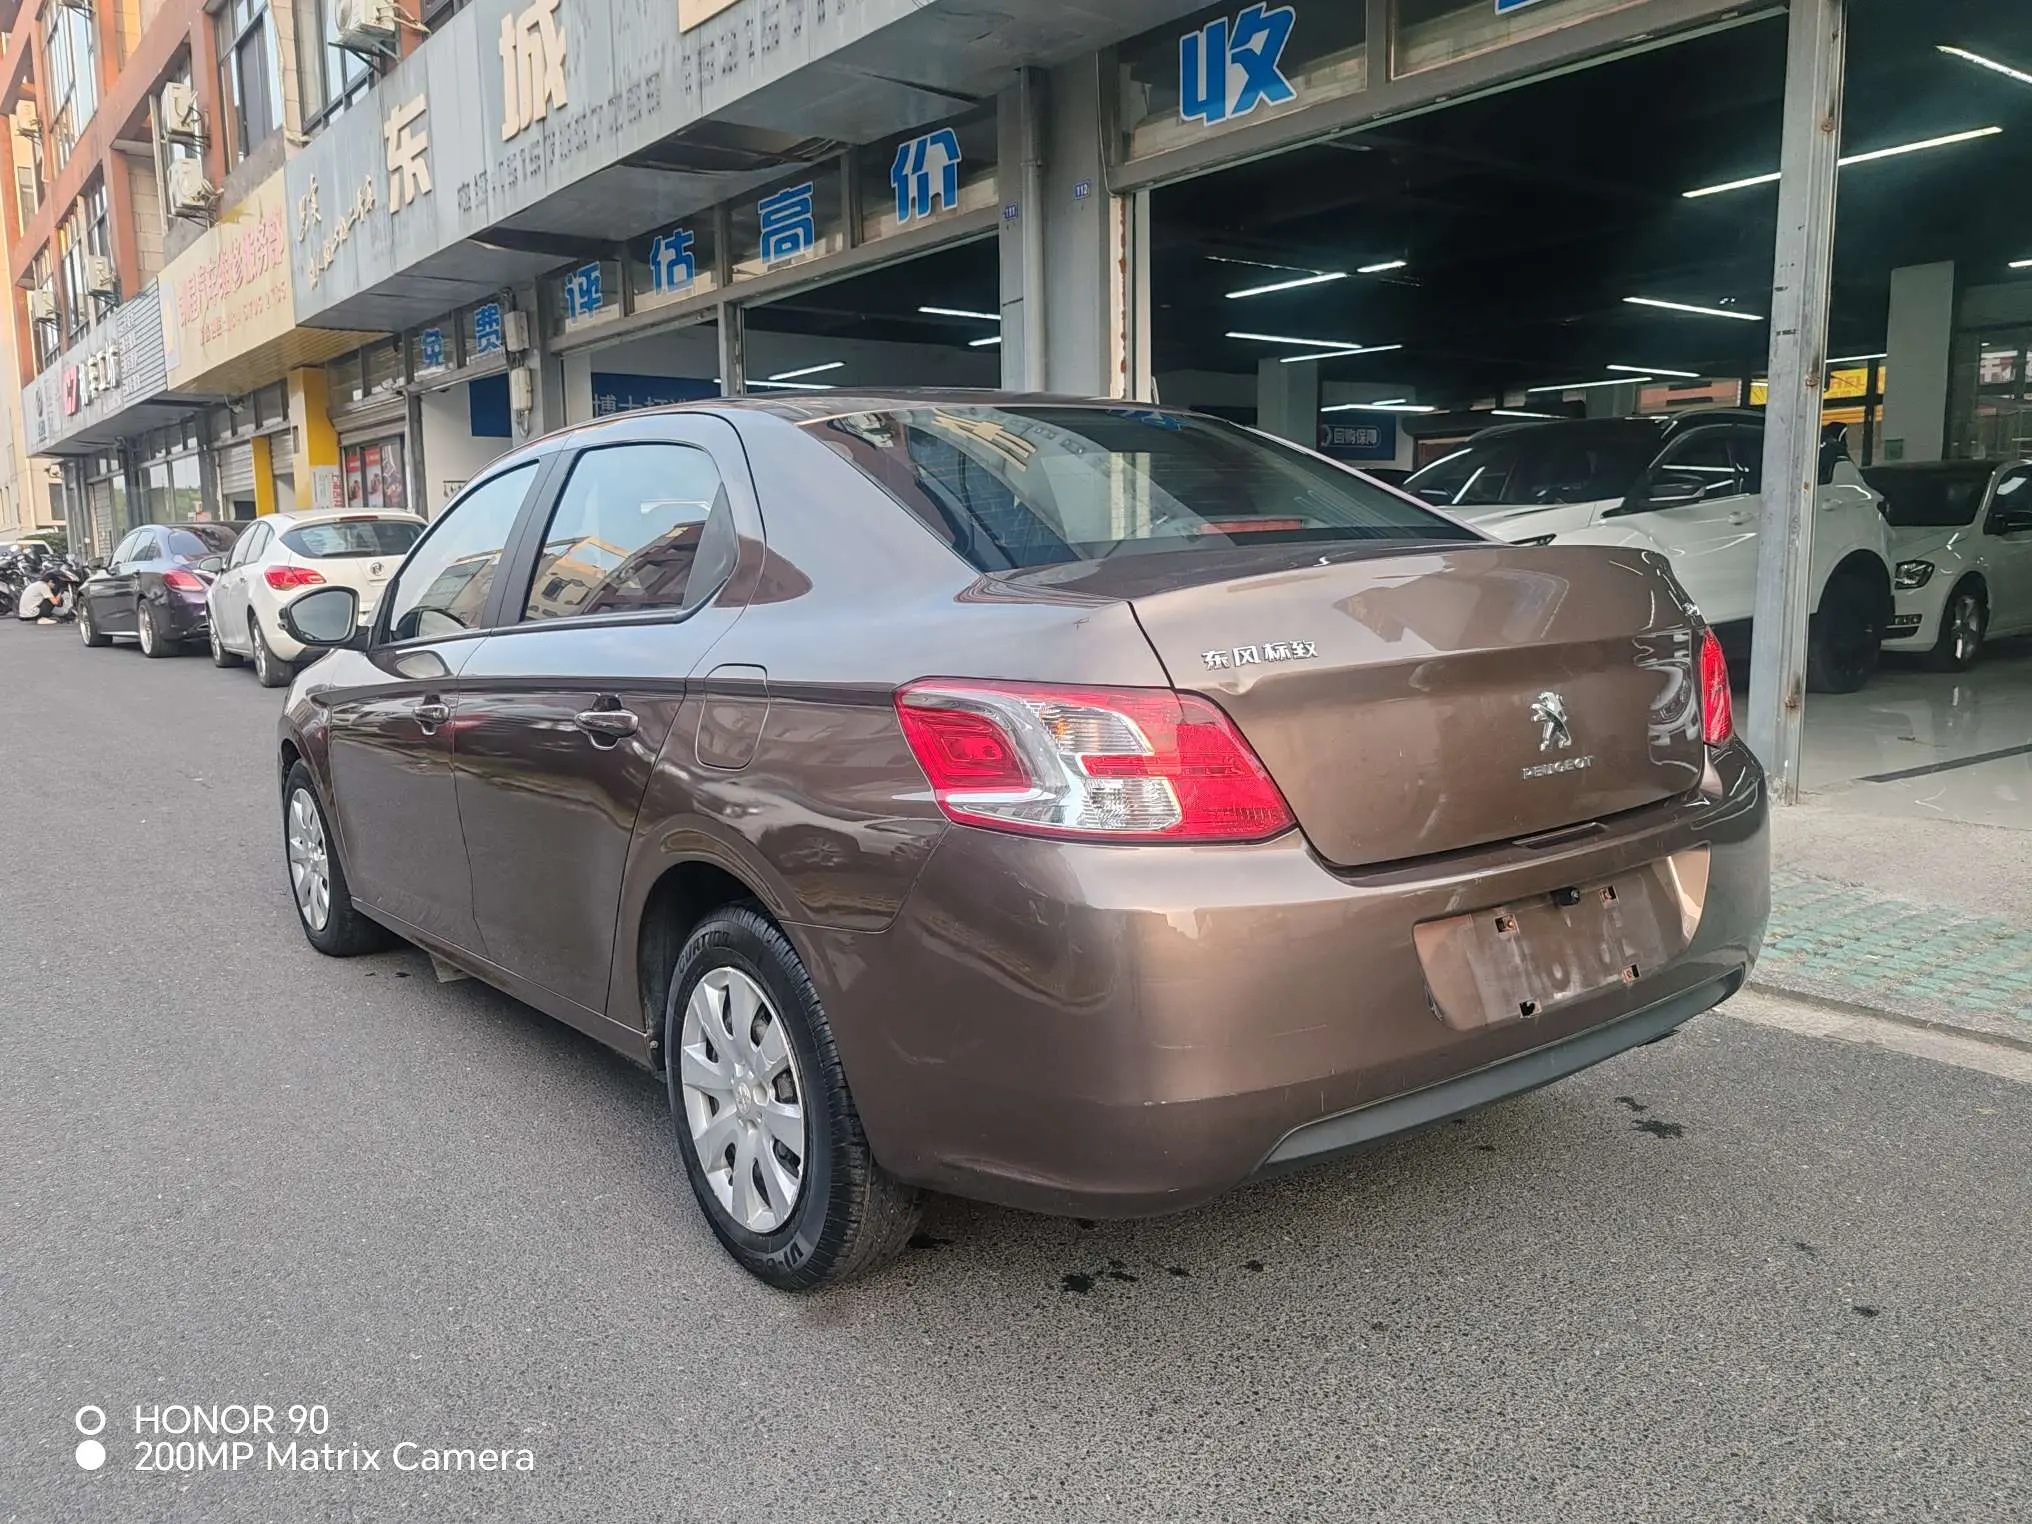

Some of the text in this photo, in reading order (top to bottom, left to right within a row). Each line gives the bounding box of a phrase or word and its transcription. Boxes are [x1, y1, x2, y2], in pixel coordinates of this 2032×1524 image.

[1075, 183, 1089, 197] 112
[1004, 204, 1017, 218] 111
[1201, 639, 1319, 670] 东风标致
[1522, 755, 1594, 780] PEUGEOT
